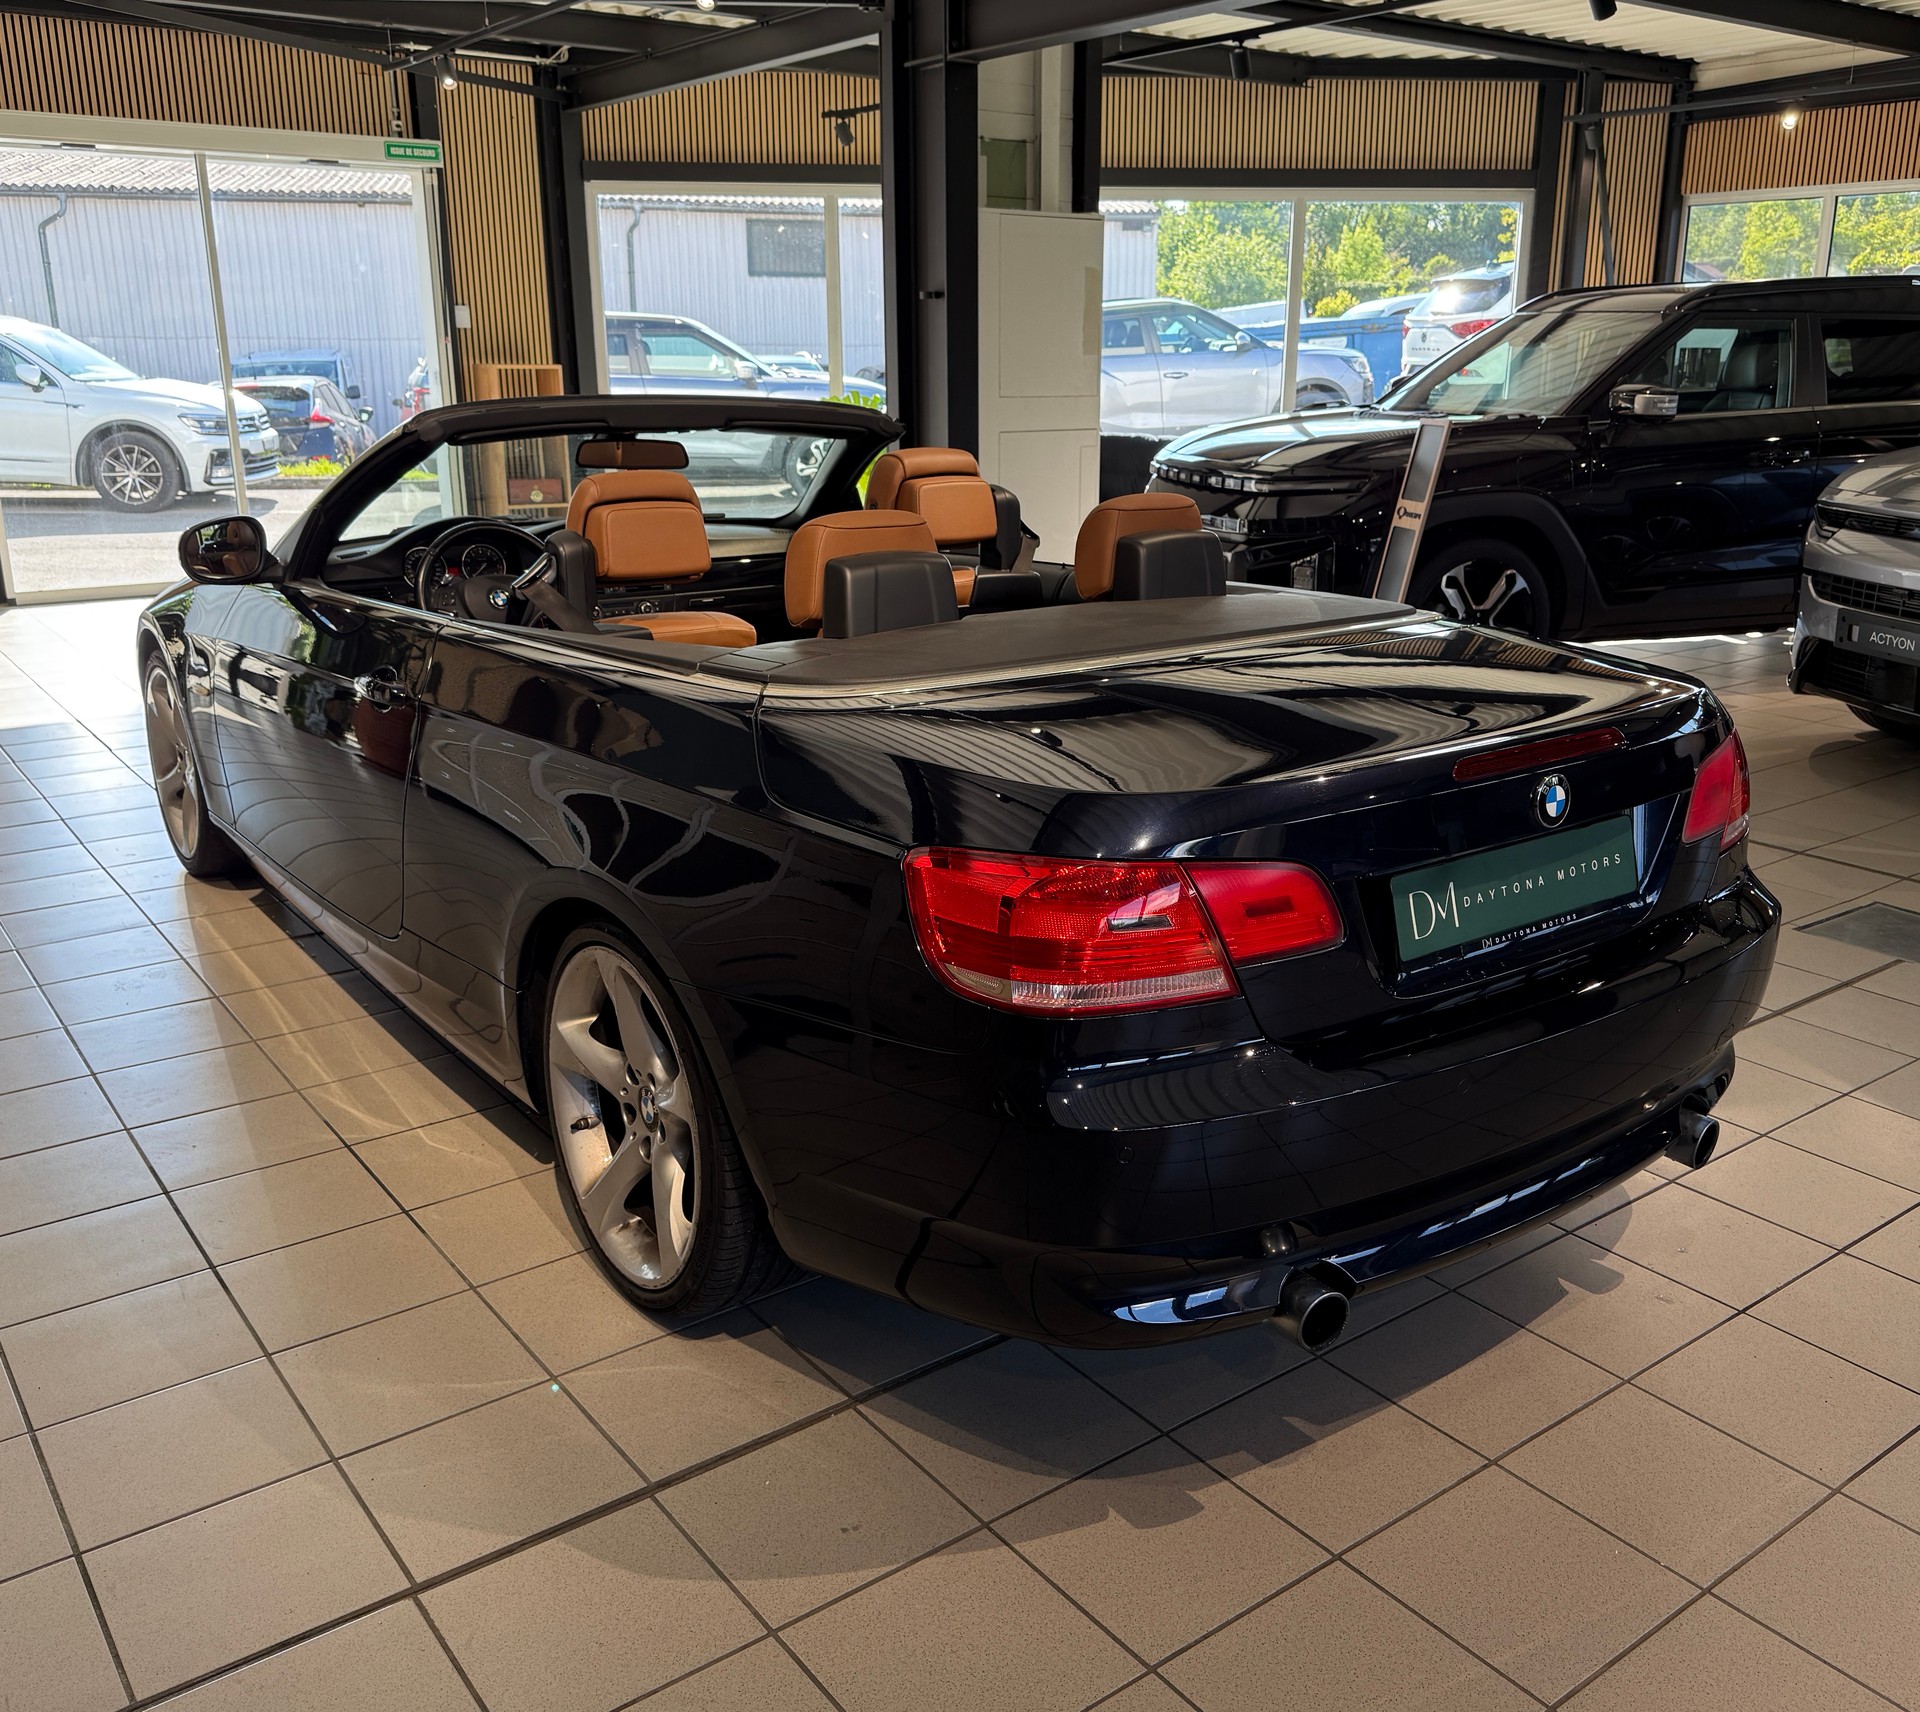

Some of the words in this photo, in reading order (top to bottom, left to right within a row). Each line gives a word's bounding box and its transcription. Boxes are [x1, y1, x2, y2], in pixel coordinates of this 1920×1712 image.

[390, 146, 405, 156] ISSUE
[405, 147, 413, 156] DE
[413, 148, 436, 157] SECOURS
[1869, 631, 1916, 652] ACTYON
[1463, 875, 1545, 908] DAYTONA
[1556, 853, 1622, 882] MOTORS
[1495, 926, 1537, 944] DAYTONA
[1541, 913, 1578, 929] MOTORS
